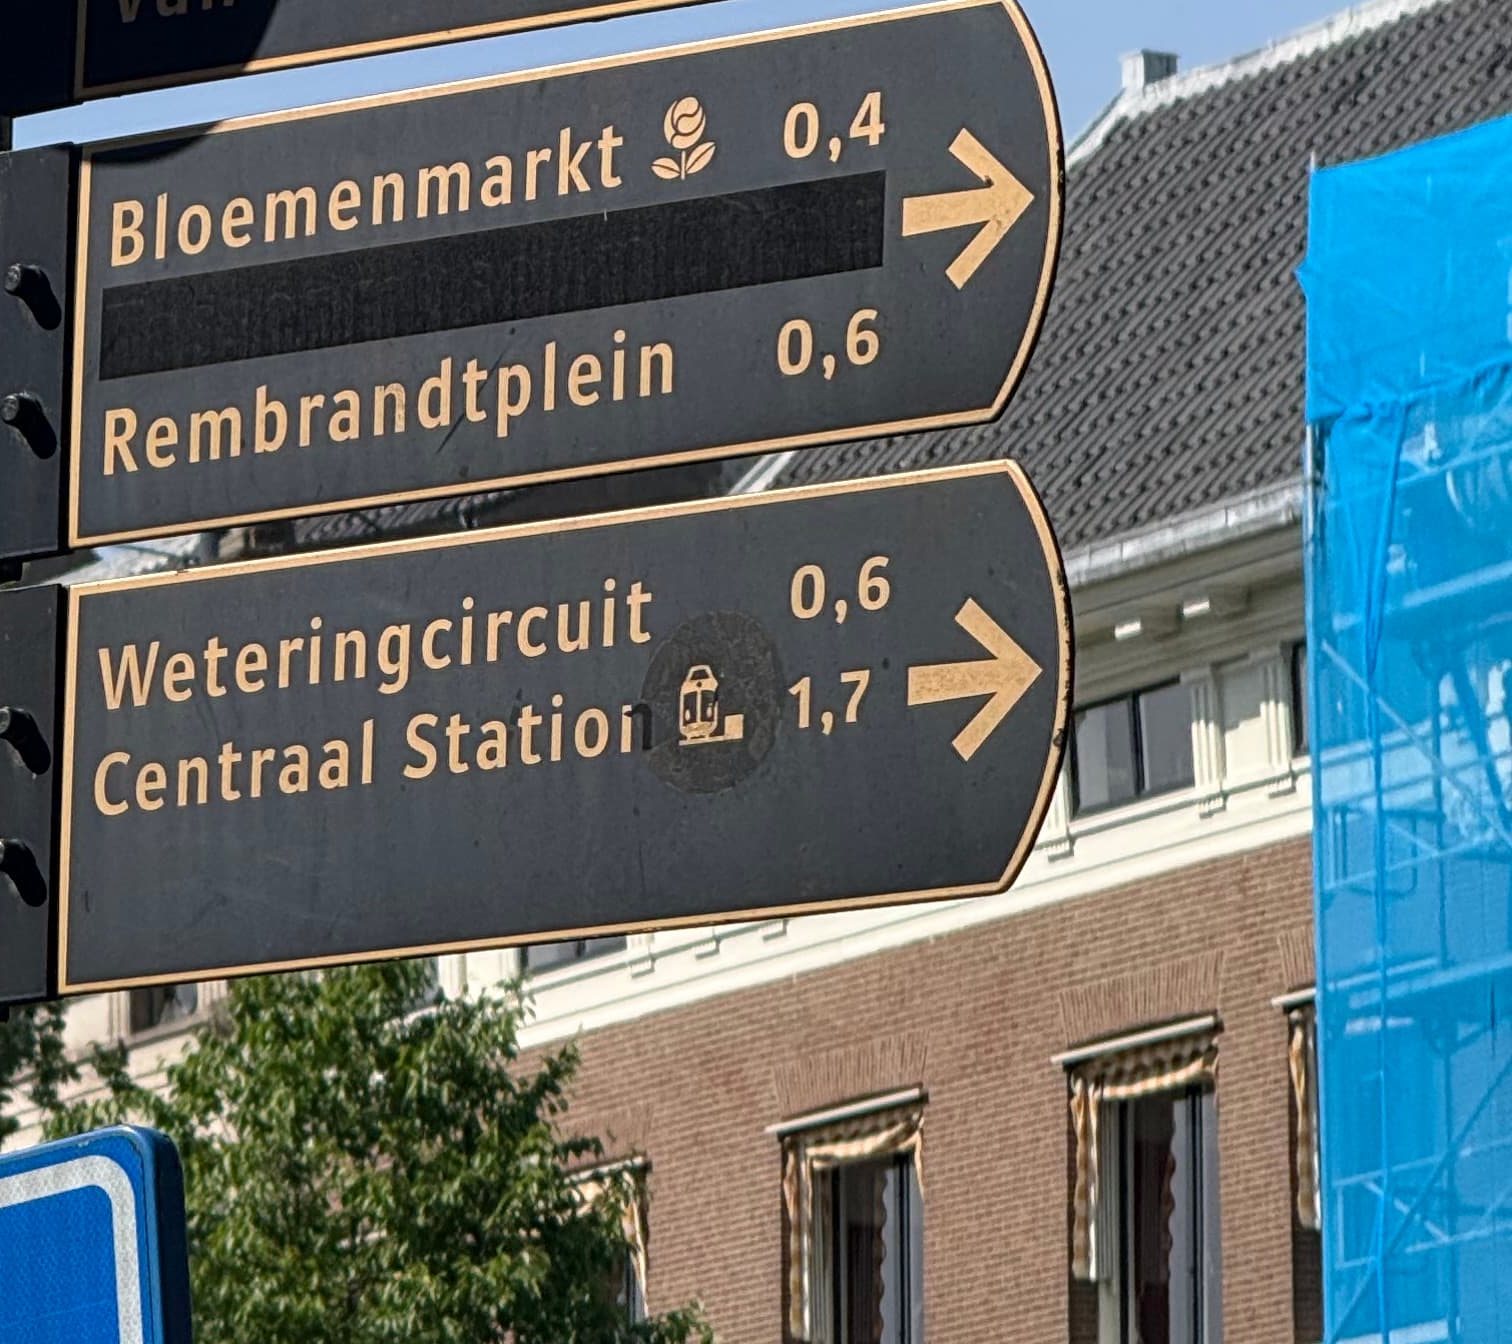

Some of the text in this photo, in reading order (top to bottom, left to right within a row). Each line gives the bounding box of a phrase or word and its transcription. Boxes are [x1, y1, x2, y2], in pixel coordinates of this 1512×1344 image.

[110, 91, 886, 268] Bloemenmarkt 0,4
[102, 308, 881, 476] Rembrandtplein 0,6
[98, 555, 890, 711] Weteringcircuit 0,6
[93, 669, 871, 816] Centraal Station 1,7
